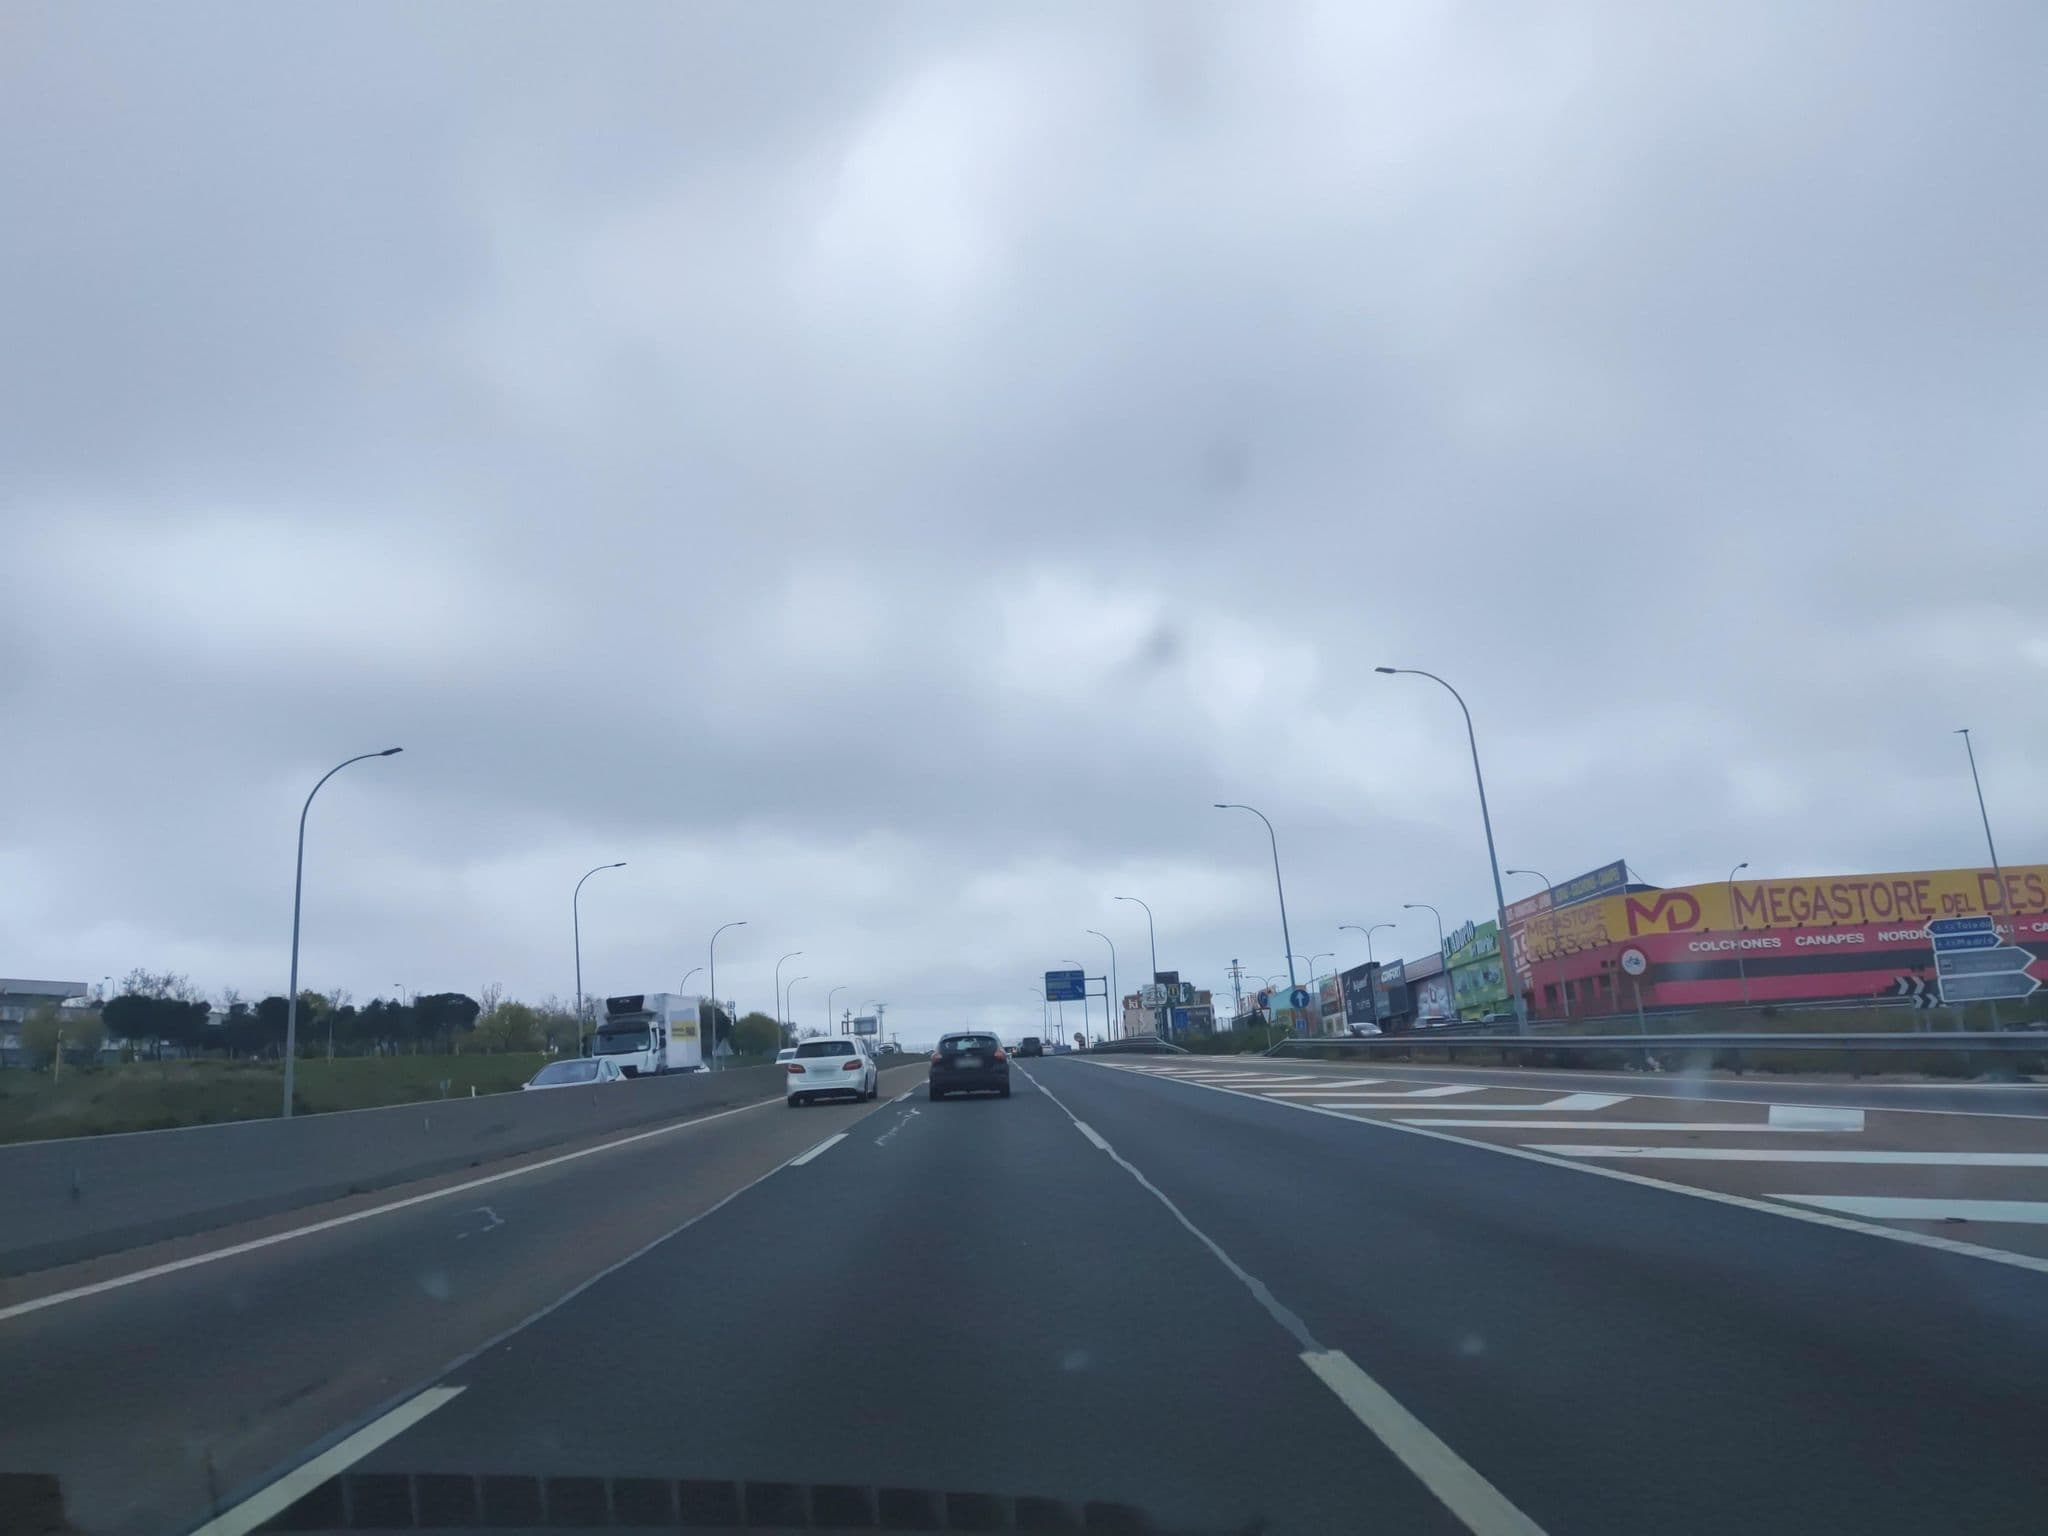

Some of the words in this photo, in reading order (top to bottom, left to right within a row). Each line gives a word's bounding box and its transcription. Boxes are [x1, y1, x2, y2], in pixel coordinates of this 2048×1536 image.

[1624, 891, 1700, 936] MD
[1732, 880, 1936, 925] MEGASTORE
[1940, 893, 1977, 914] DEL
[1688, 938, 1782, 951] COLCHONES
[1795, 932, 1865, 946] CANAPES
